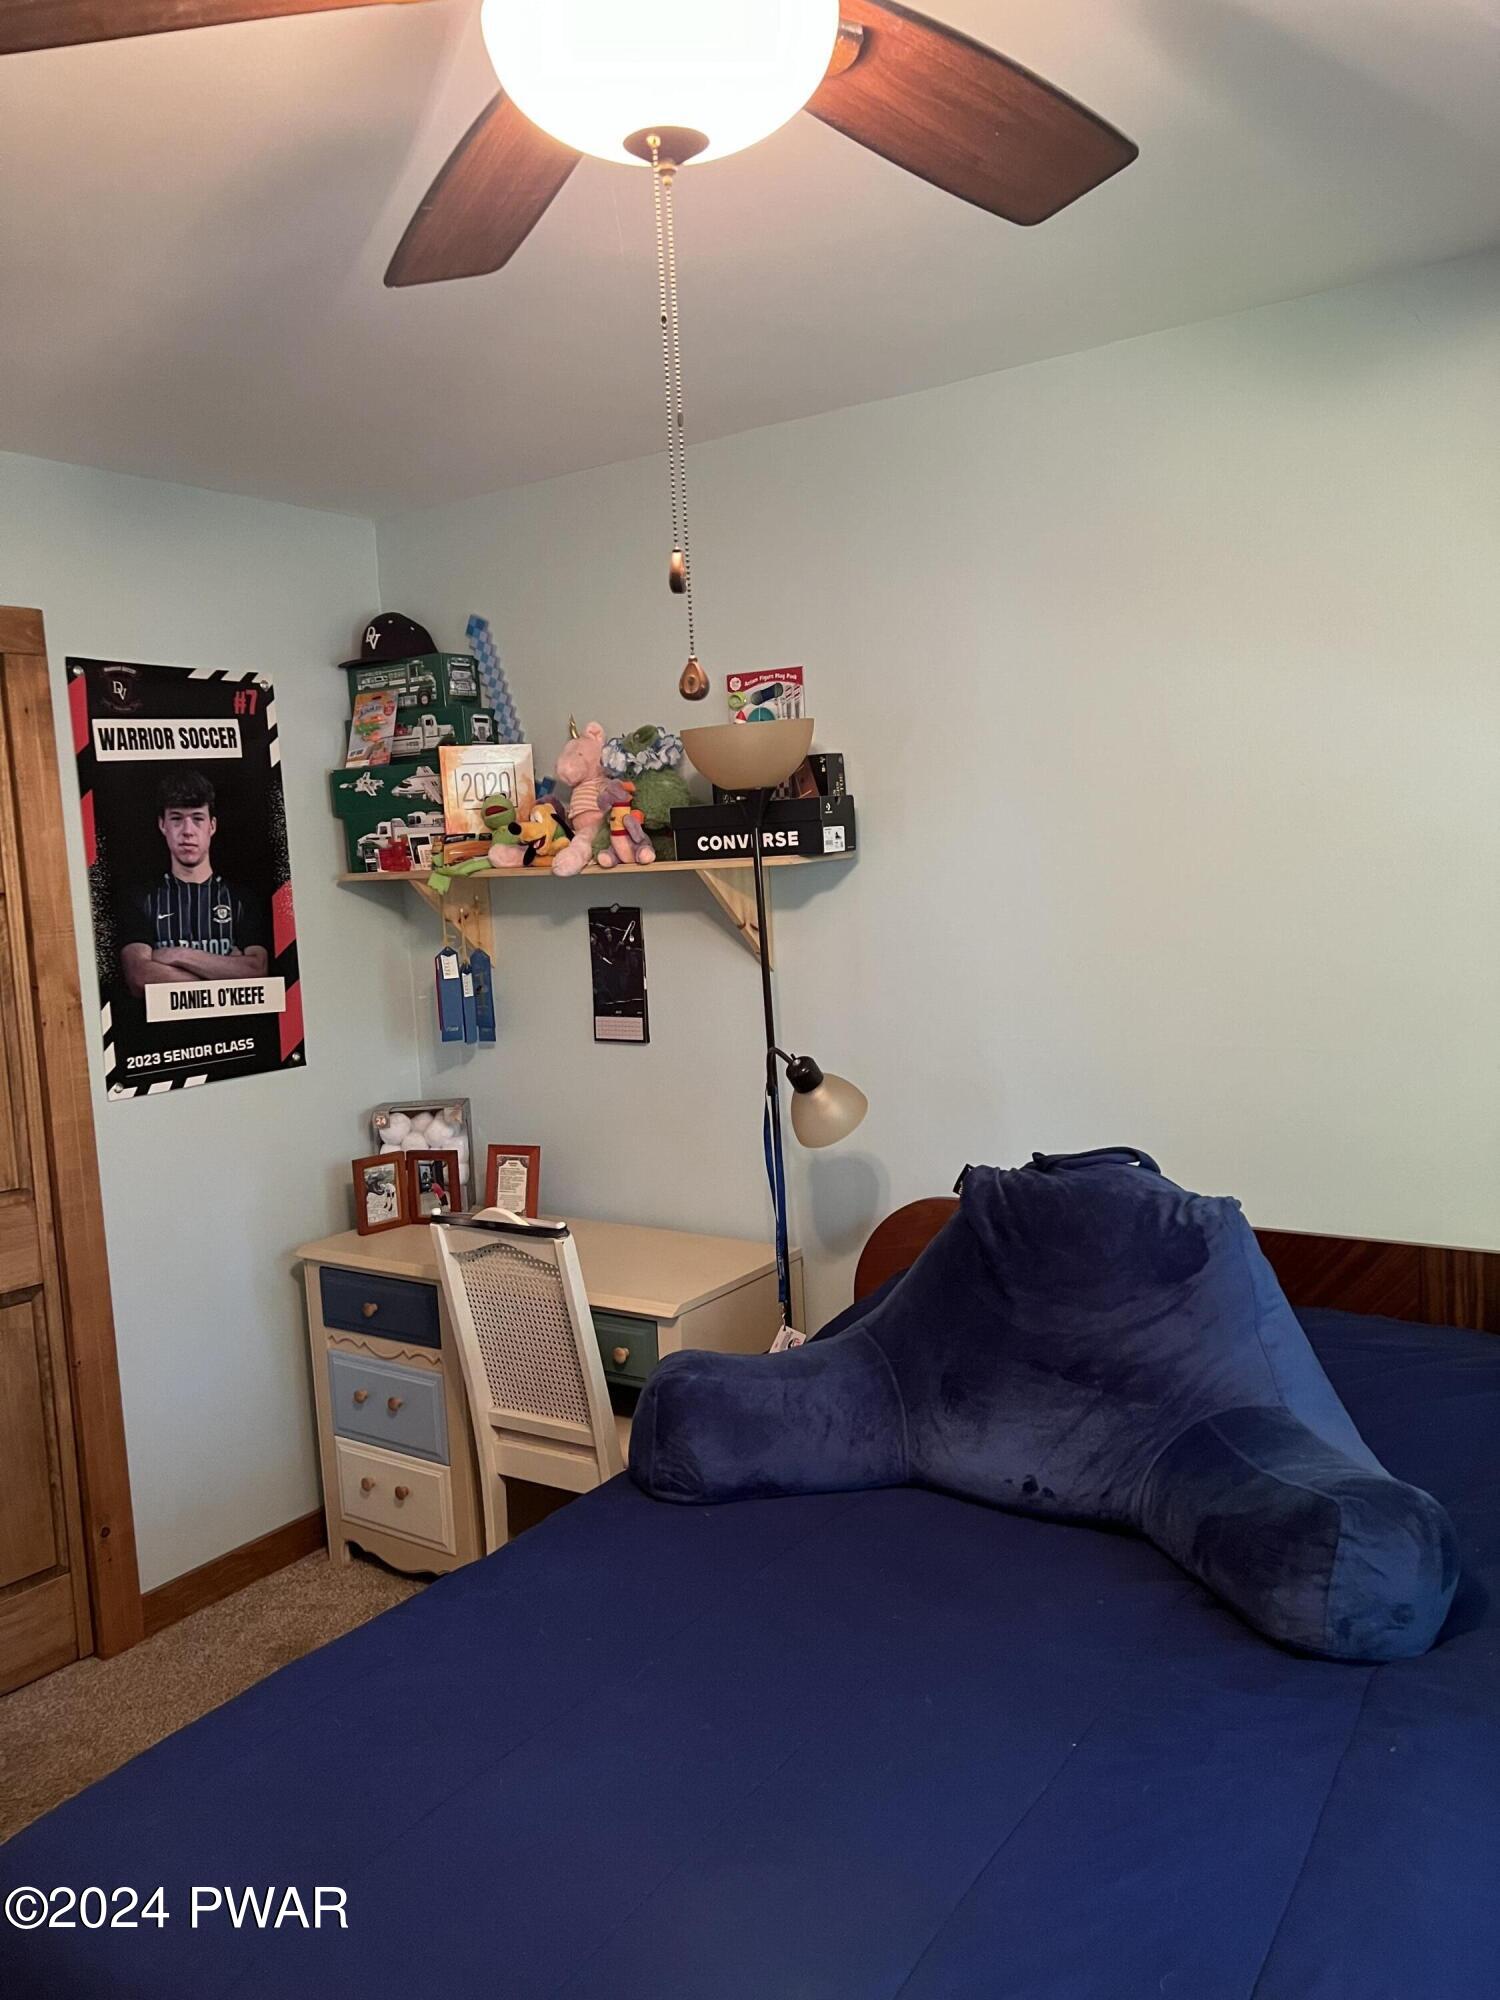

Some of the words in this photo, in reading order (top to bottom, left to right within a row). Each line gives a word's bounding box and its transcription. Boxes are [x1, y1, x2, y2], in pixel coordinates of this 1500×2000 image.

[774, 672, 785, 680] Play
[234, 690, 257, 715] #7
[98, 727, 175, 751] WARRIOR
[179, 727, 238, 749] SOCCER
[461, 771, 511, 802] 2020
[697, 831, 799, 851] CONVRSE
[170, 988, 215, 1011] DANIEL
[218, 985, 265, 1007] O'KEEFE
[126, 1052, 161, 1069] 2023
[163, 1045, 213, 1064] SENIOR
[215, 1037, 255, 1055] CLASS
